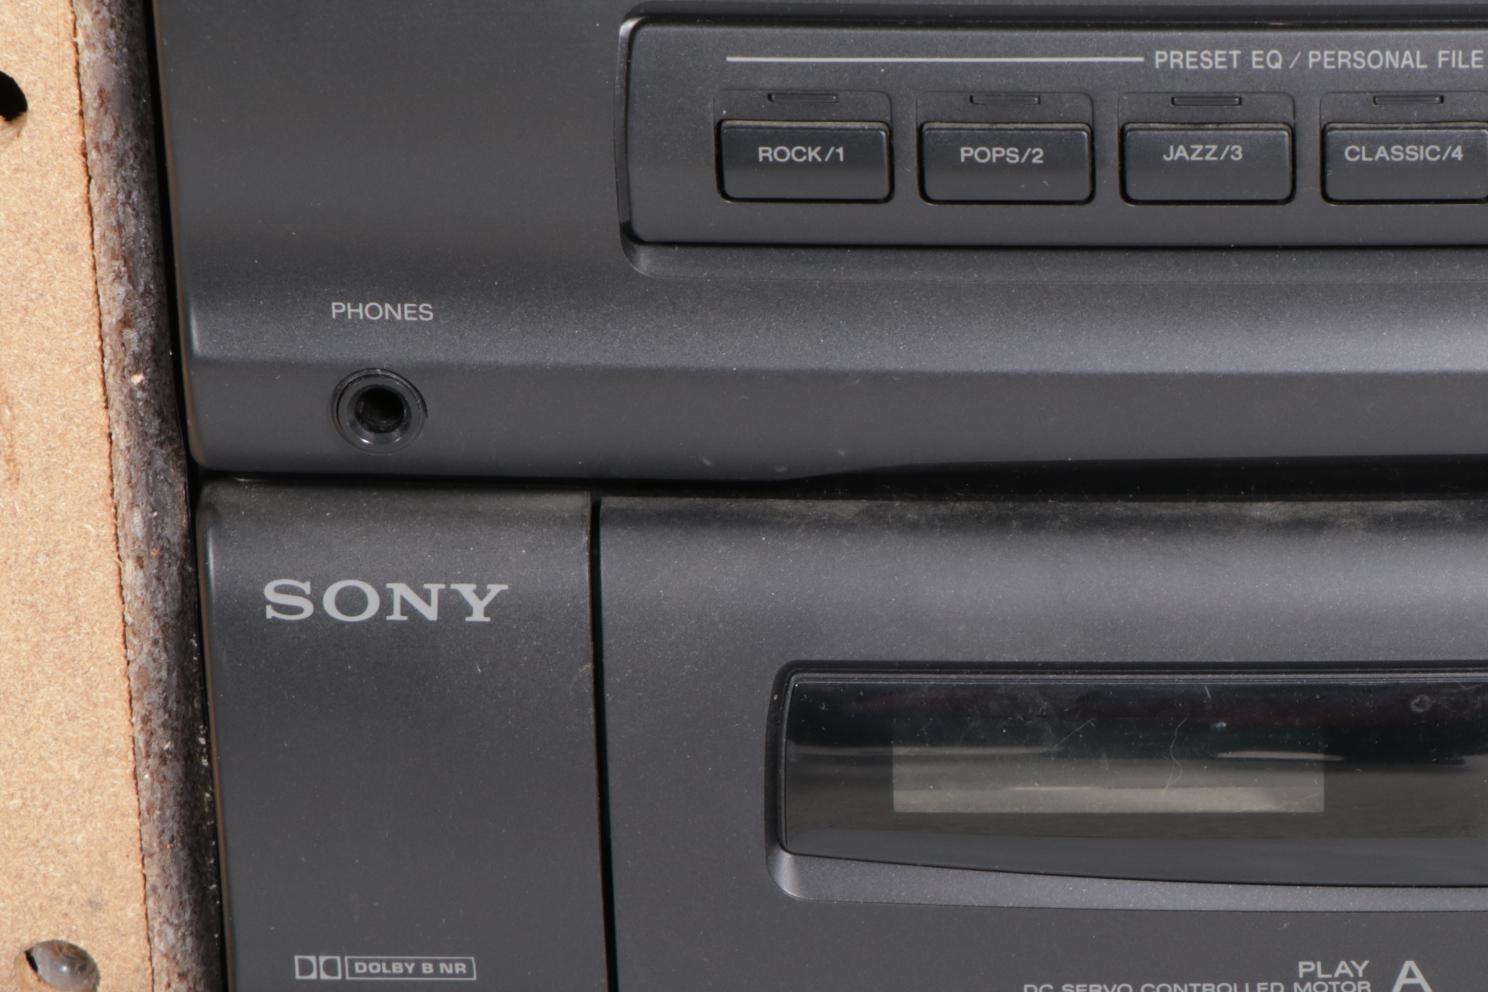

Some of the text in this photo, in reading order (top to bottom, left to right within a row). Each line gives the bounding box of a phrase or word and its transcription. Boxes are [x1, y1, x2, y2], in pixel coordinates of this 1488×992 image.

[1154, 50, 1241, 70] PRESET
[1251, 50, 1282, 70] EQ
[1308, 50, 1428, 70] PERSONAL
[1437, 50, 1484, 69] FILE
[757, 146, 844, 163] ROCK/1
[960, 147, 1044, 165] POPS/2
[1162, 145, 1243, 162] JAZZ/3
[1344, 145, 1464, 163] CLASSIC/4
[331, 302, 434, 321] PHONES
[263, 579, 508, 622] SONY
[354, 962, 467, 974] DOLBY B NR
[1298, 960, 1370, 978] PLAY
